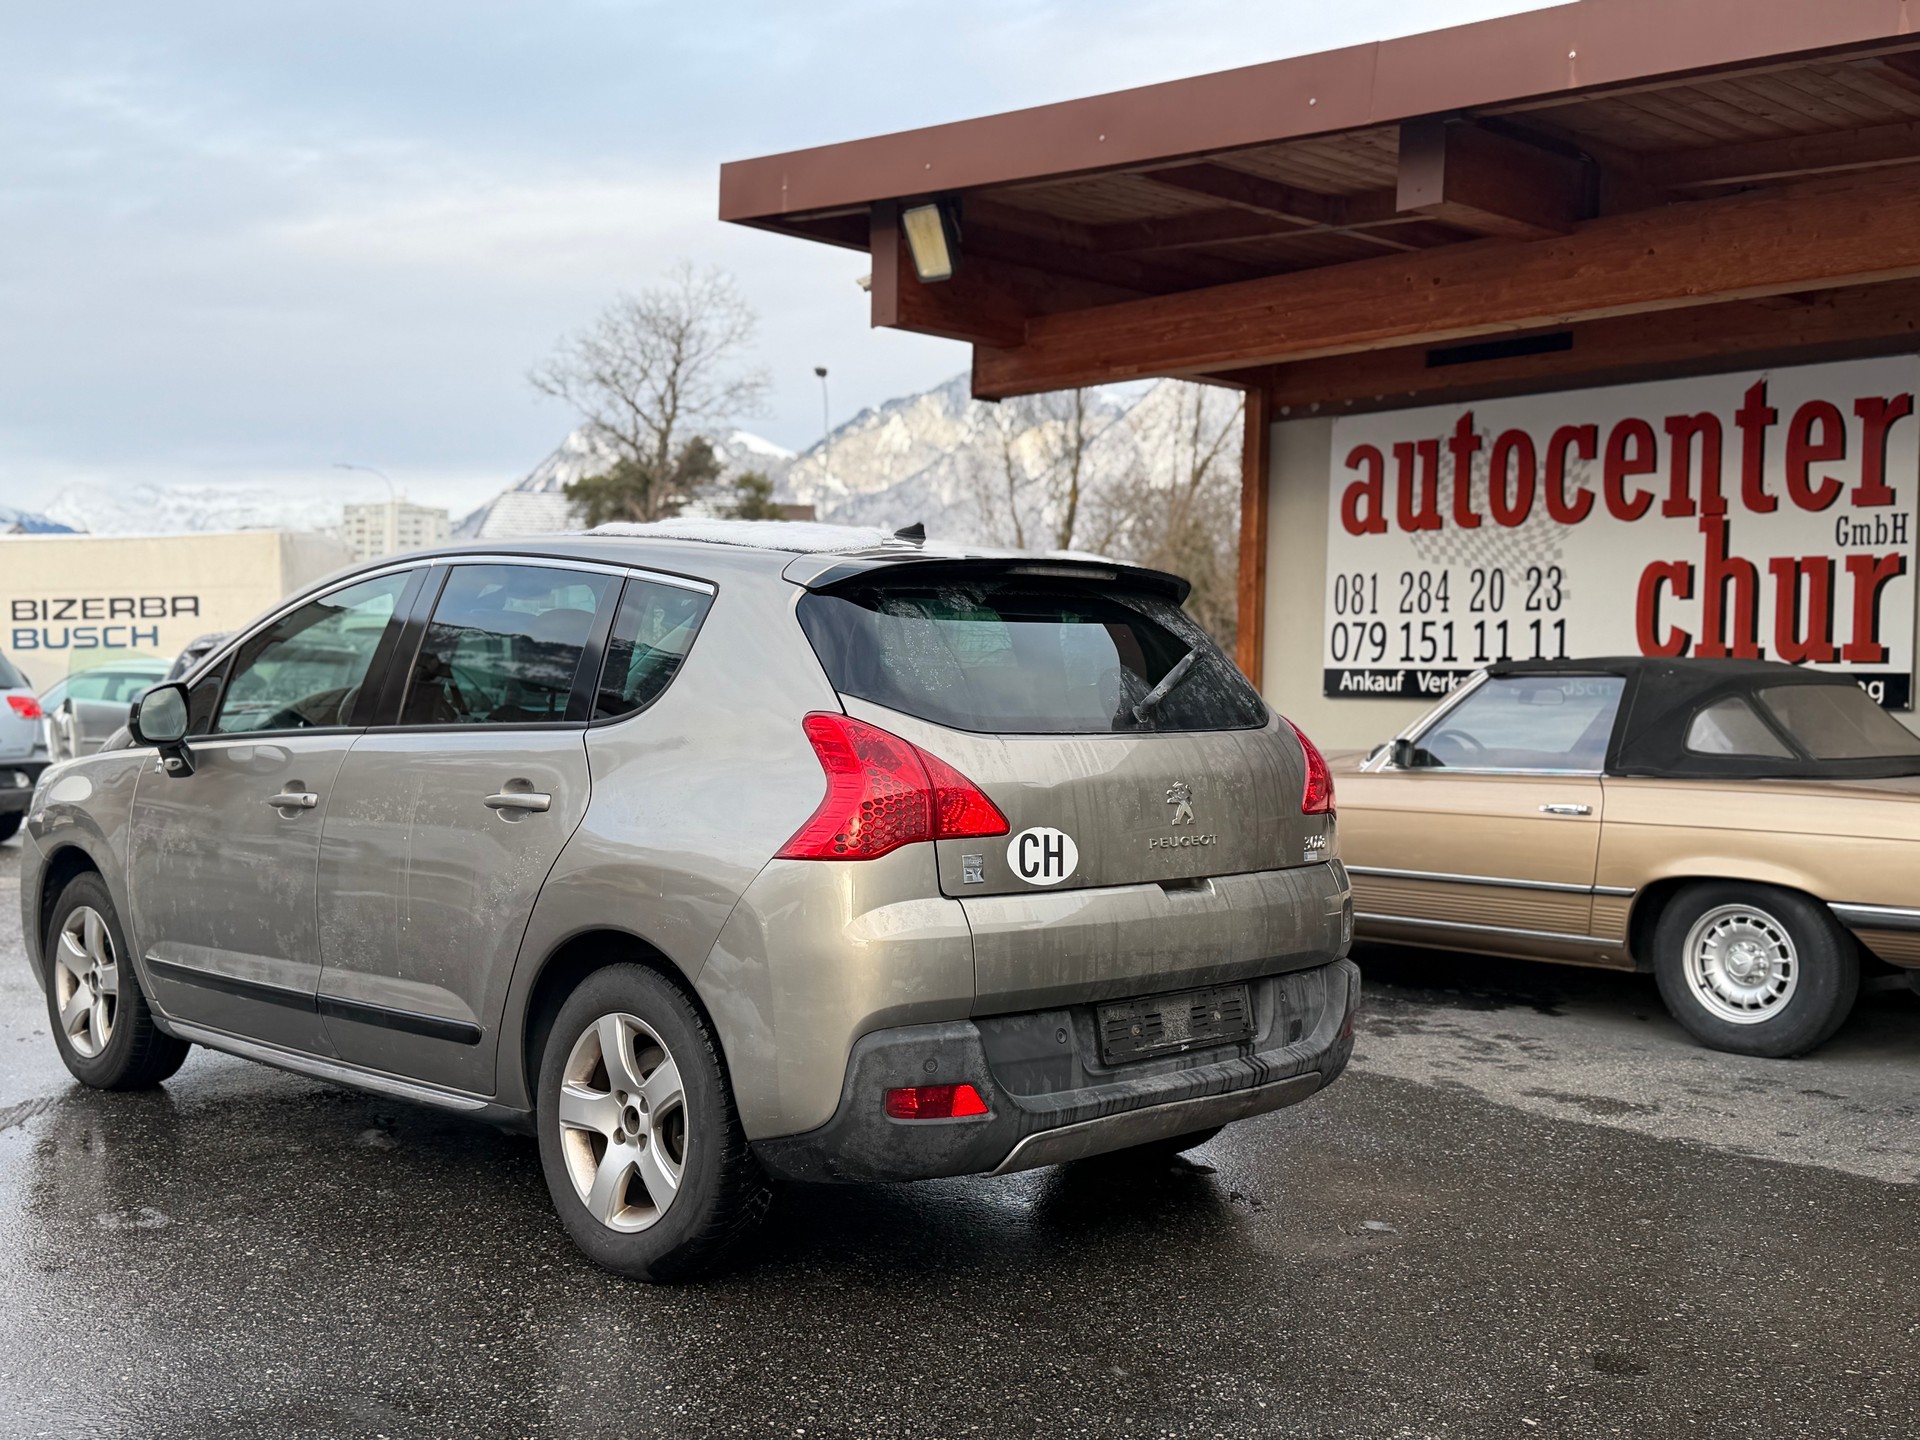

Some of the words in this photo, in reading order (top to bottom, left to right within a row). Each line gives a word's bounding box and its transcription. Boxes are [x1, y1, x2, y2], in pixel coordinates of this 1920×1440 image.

[1340, 378, 1914, 537] autocenter
[1834, 512, 1909, 547] GmbH
[11, 595, 200, 621] BIZERBA
[1333, 572, 1379, 616] 081
[1399, 569, 1450, 614] 284
[1469, 566, 1505, 613] 20
[1525, 565, 1563, 612] 23
[1635, 512, 1907, 664] chur
[12, 625, 159, 650] BUSCH
[1330, 621, 1388, 663] 079
[1399, 620, 1458, 664] 151
[1472, 618, 1513, 662] 11
[1529, 617, 1571, 661] 11
[1339, 670, 1405, 692] Ankauf
[1416, 670, 1467, 693] Verk
[1019, 833, 1064, 878] CH
[1149, 834, 1219, 849] PEUGEOT
